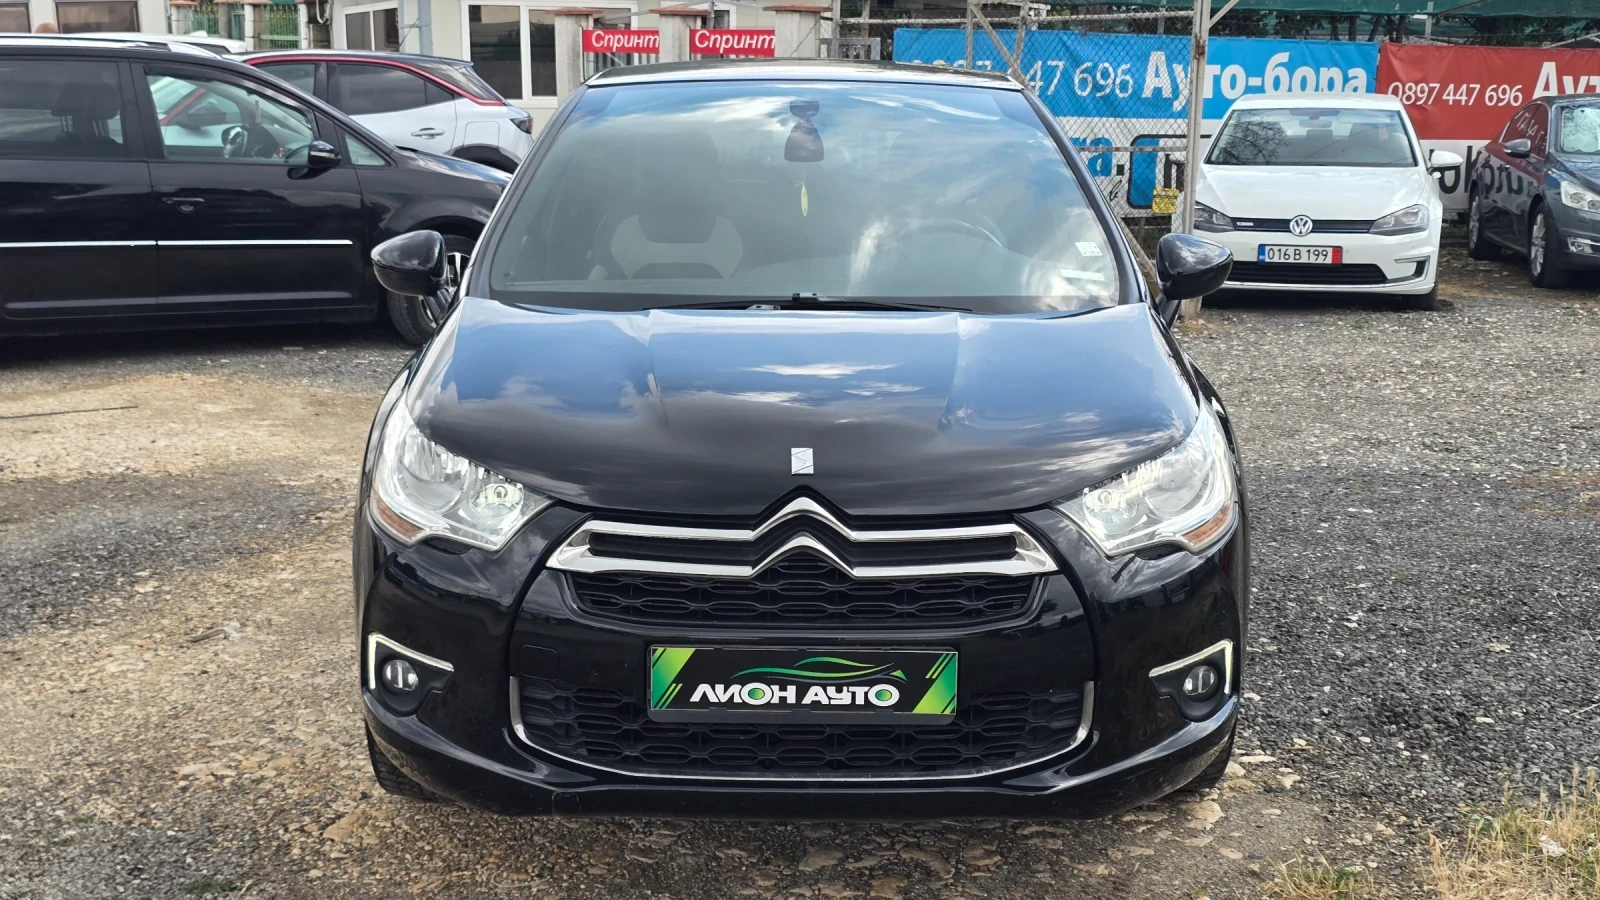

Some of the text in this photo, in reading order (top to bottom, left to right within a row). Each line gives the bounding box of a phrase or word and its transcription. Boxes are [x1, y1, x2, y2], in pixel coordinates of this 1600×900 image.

[591, 30, 660, 52] Спринт
[694, 30, 776, 53] Спринт
[1074, 61, 1134, 98] 696
[1388, 81, 1440, 105] 0897
[1442, 83, 1481, 106] 447
[1484, 84, 1524, 107] 696
[1267, 247, 1291, 261] 016
[1306, 249, 1329, 262] 199
[689, 682, 900, 707] ЛИОН АУТО
